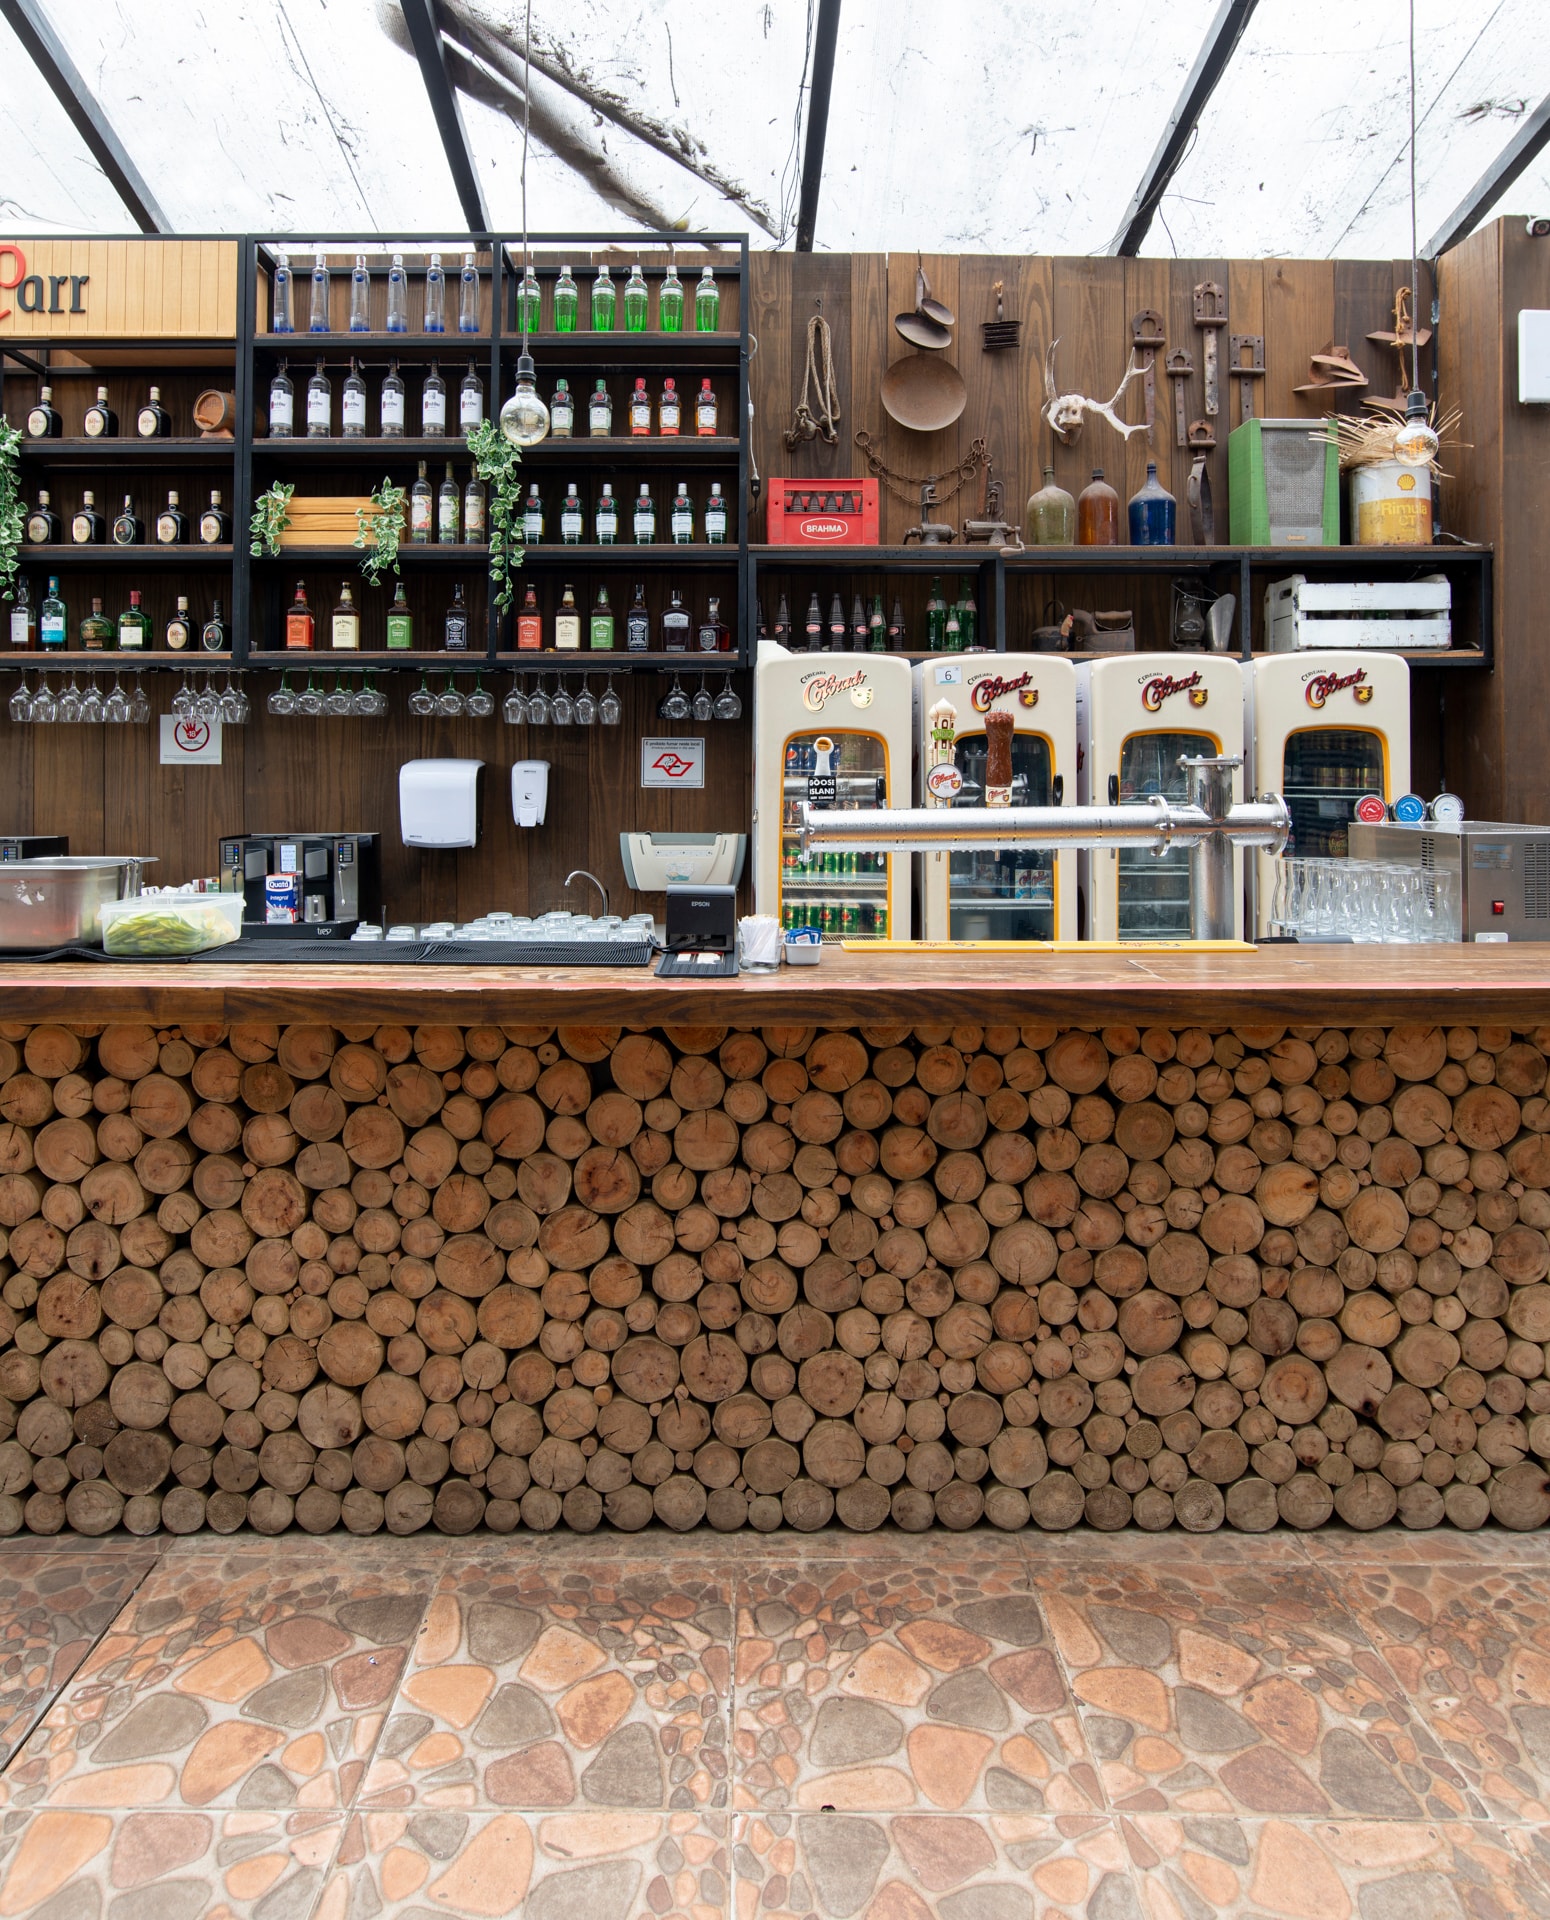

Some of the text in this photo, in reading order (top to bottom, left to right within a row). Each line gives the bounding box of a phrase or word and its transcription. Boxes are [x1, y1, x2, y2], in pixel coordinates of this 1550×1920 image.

[1381, 501, 1427, 516] Rimula
[1399, 514, 1416, 526] CT
[806, 525, 842, 533] BRAHMA
[944, 670, 952, 681] 6
[803, 669, 867, 712] Colorado
[971, 671, 1033, 712] Colorado
[1142, 671, 1202, 712] Colorado
[1305, 667, 1368, 709] Colorado
[809, 779, 835, 787] GOOSE
[930, 772, 957, 789] Colorado
[269, 880, 289, 888] Quatá
